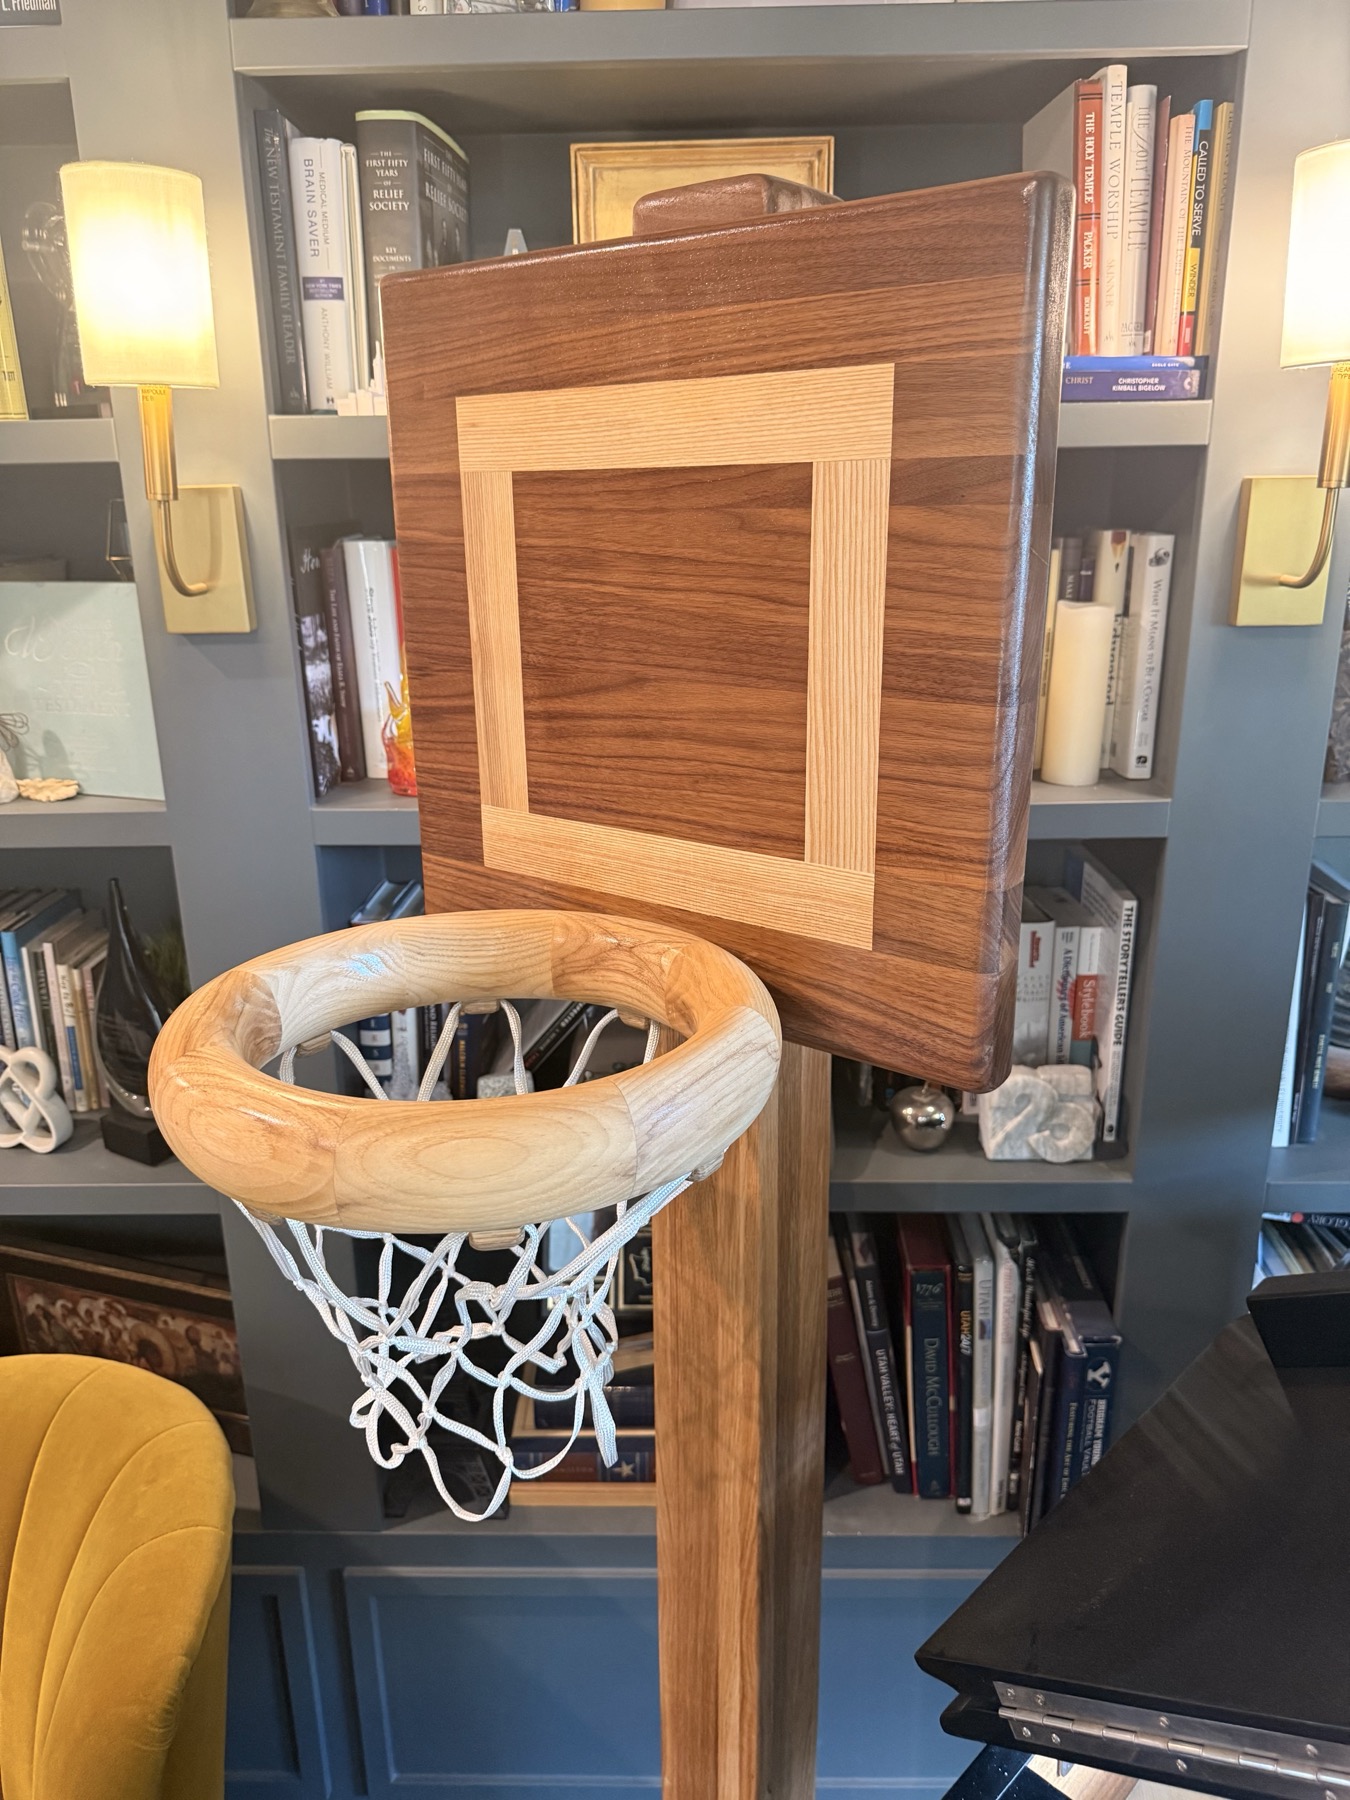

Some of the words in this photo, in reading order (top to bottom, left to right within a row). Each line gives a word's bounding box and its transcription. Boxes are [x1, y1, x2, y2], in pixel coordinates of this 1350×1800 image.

[1085, 112, 1095, 134] THE
[1109, 82, 1123, 151] TEMPLE
[266, 147, 278, 179] NEW
[1085, 136, 1095, 162] HOLY
[1196, 140, 1209, 182] CALLED
[303, 159, 316, 203] BRAIN
[319, 172, 328, 209] MEDICAL
[375, 169, 398, 177] YEARS
[1084, 163, 1095, 204] TEMPLE
[1180, 149, 1192, 204] MOUNTAIN
[369, 201, 410, 211] SOCIETY
[373, 189, 404, 199] RELIEF
[1107, 158, 1121, 240] WORSHIP
[1194, 183, 1205, 201] TO
[269, 185, 286, 260] TESTAMENT
[321, 211, 330, 245] MEDIUM
[1127, 174, 1151, 252] TEMPLE
[1191, 202, 1203, 236] SERVE
[307, 209, 320, 257] SAVER
[1083, 231, 1094, 270] PACKER
[277, 265, 290, 309] FAMILY
[1187, 263, 1198, 298] WINDER
[282, 314, 296, 364] READER
[321, 307, 331, 351] ANTHONY
[1065, 376, 1094, 385] CHRIST
[1112, 384, 1137, 392] KIMBALL
[1138, 384, 1167, 392] BIGELOW
[1122, 906, 1134, 928] THE
[1116, 931, 1132, 1011] STORYTELLERS
[1079, 979, 1096, 1039] Stylebook
[1056, 1015, 1068, 1053] American
[1112, 1014, 1125, 1046] GUIDE
[916, 1283, 943, 1296] 1776
[875, 1348, 890, 1374] UTAH
[924, 1338, 939, 1373] DAVID
[886, 1412, 900, 1443] HEART
[1084, 1399, 1097, 1445] FOOTBALL
[892, 1451, 904, 1475] UTAH
[1091, 1439, 1102, 1466] YOUN
